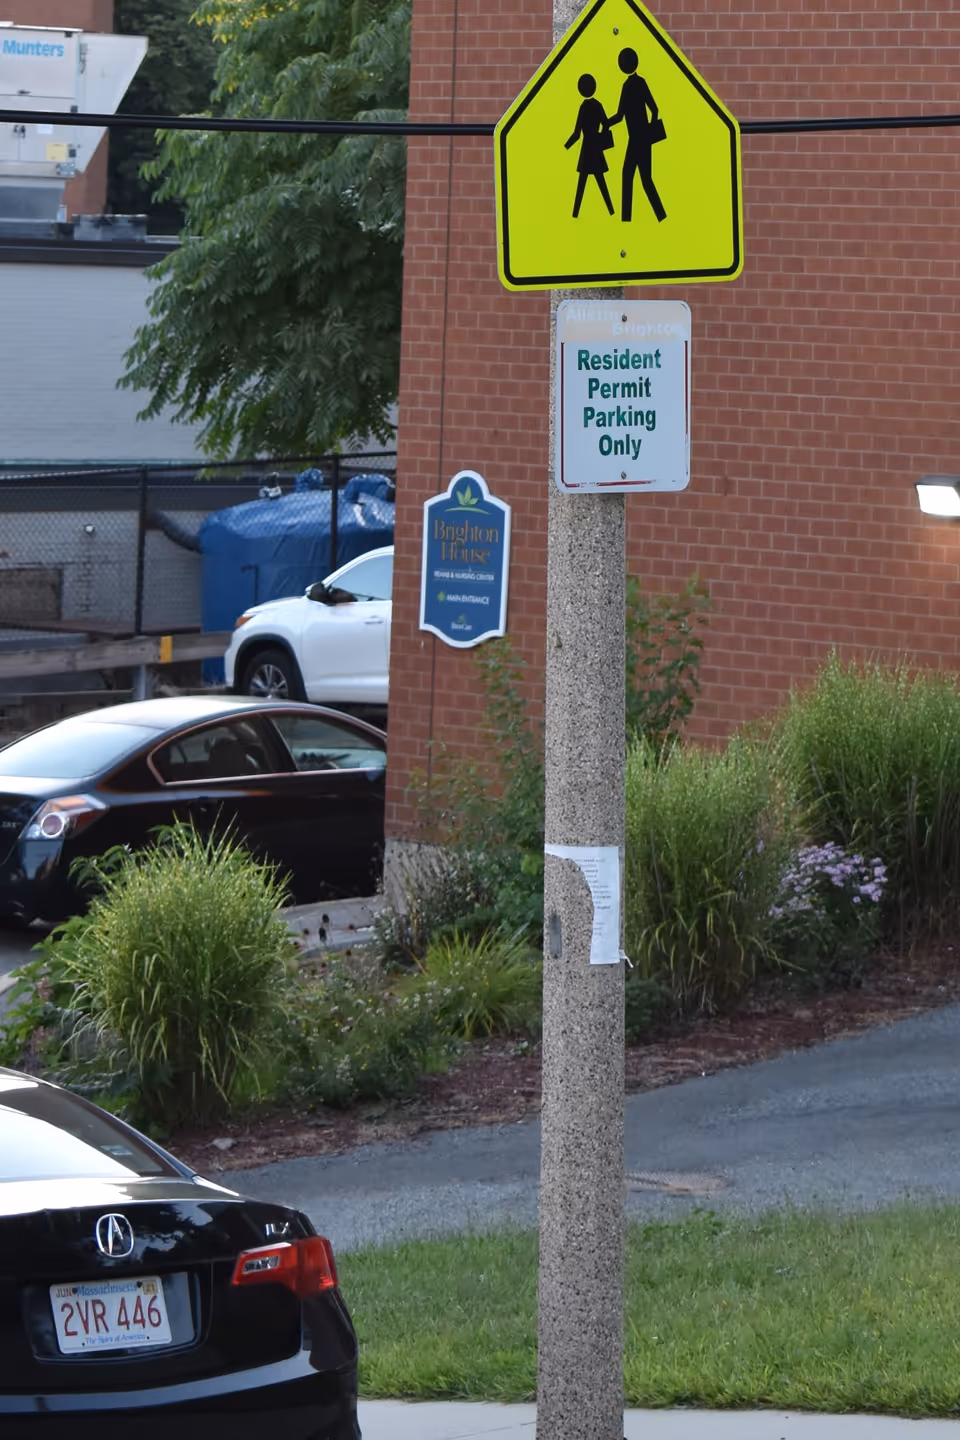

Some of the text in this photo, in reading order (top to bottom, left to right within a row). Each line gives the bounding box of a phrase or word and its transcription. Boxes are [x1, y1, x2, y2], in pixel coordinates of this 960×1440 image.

[2, 40, 65, 57] Munters
[577, 348, 661, 370] Resident
[588, 377, 651, 399] Permit
[583, 405, 656, 431] Parking
[599, 434, 642, 460] Only
[434, 520, 498, 546] Brighton
[442, 541, 490, 564] House
[56, 1288, 73, 1297] JUN
[76, 1281, 138, 1297] Massachusetts
[61, 1295, 162, 1337] 2VR 446
